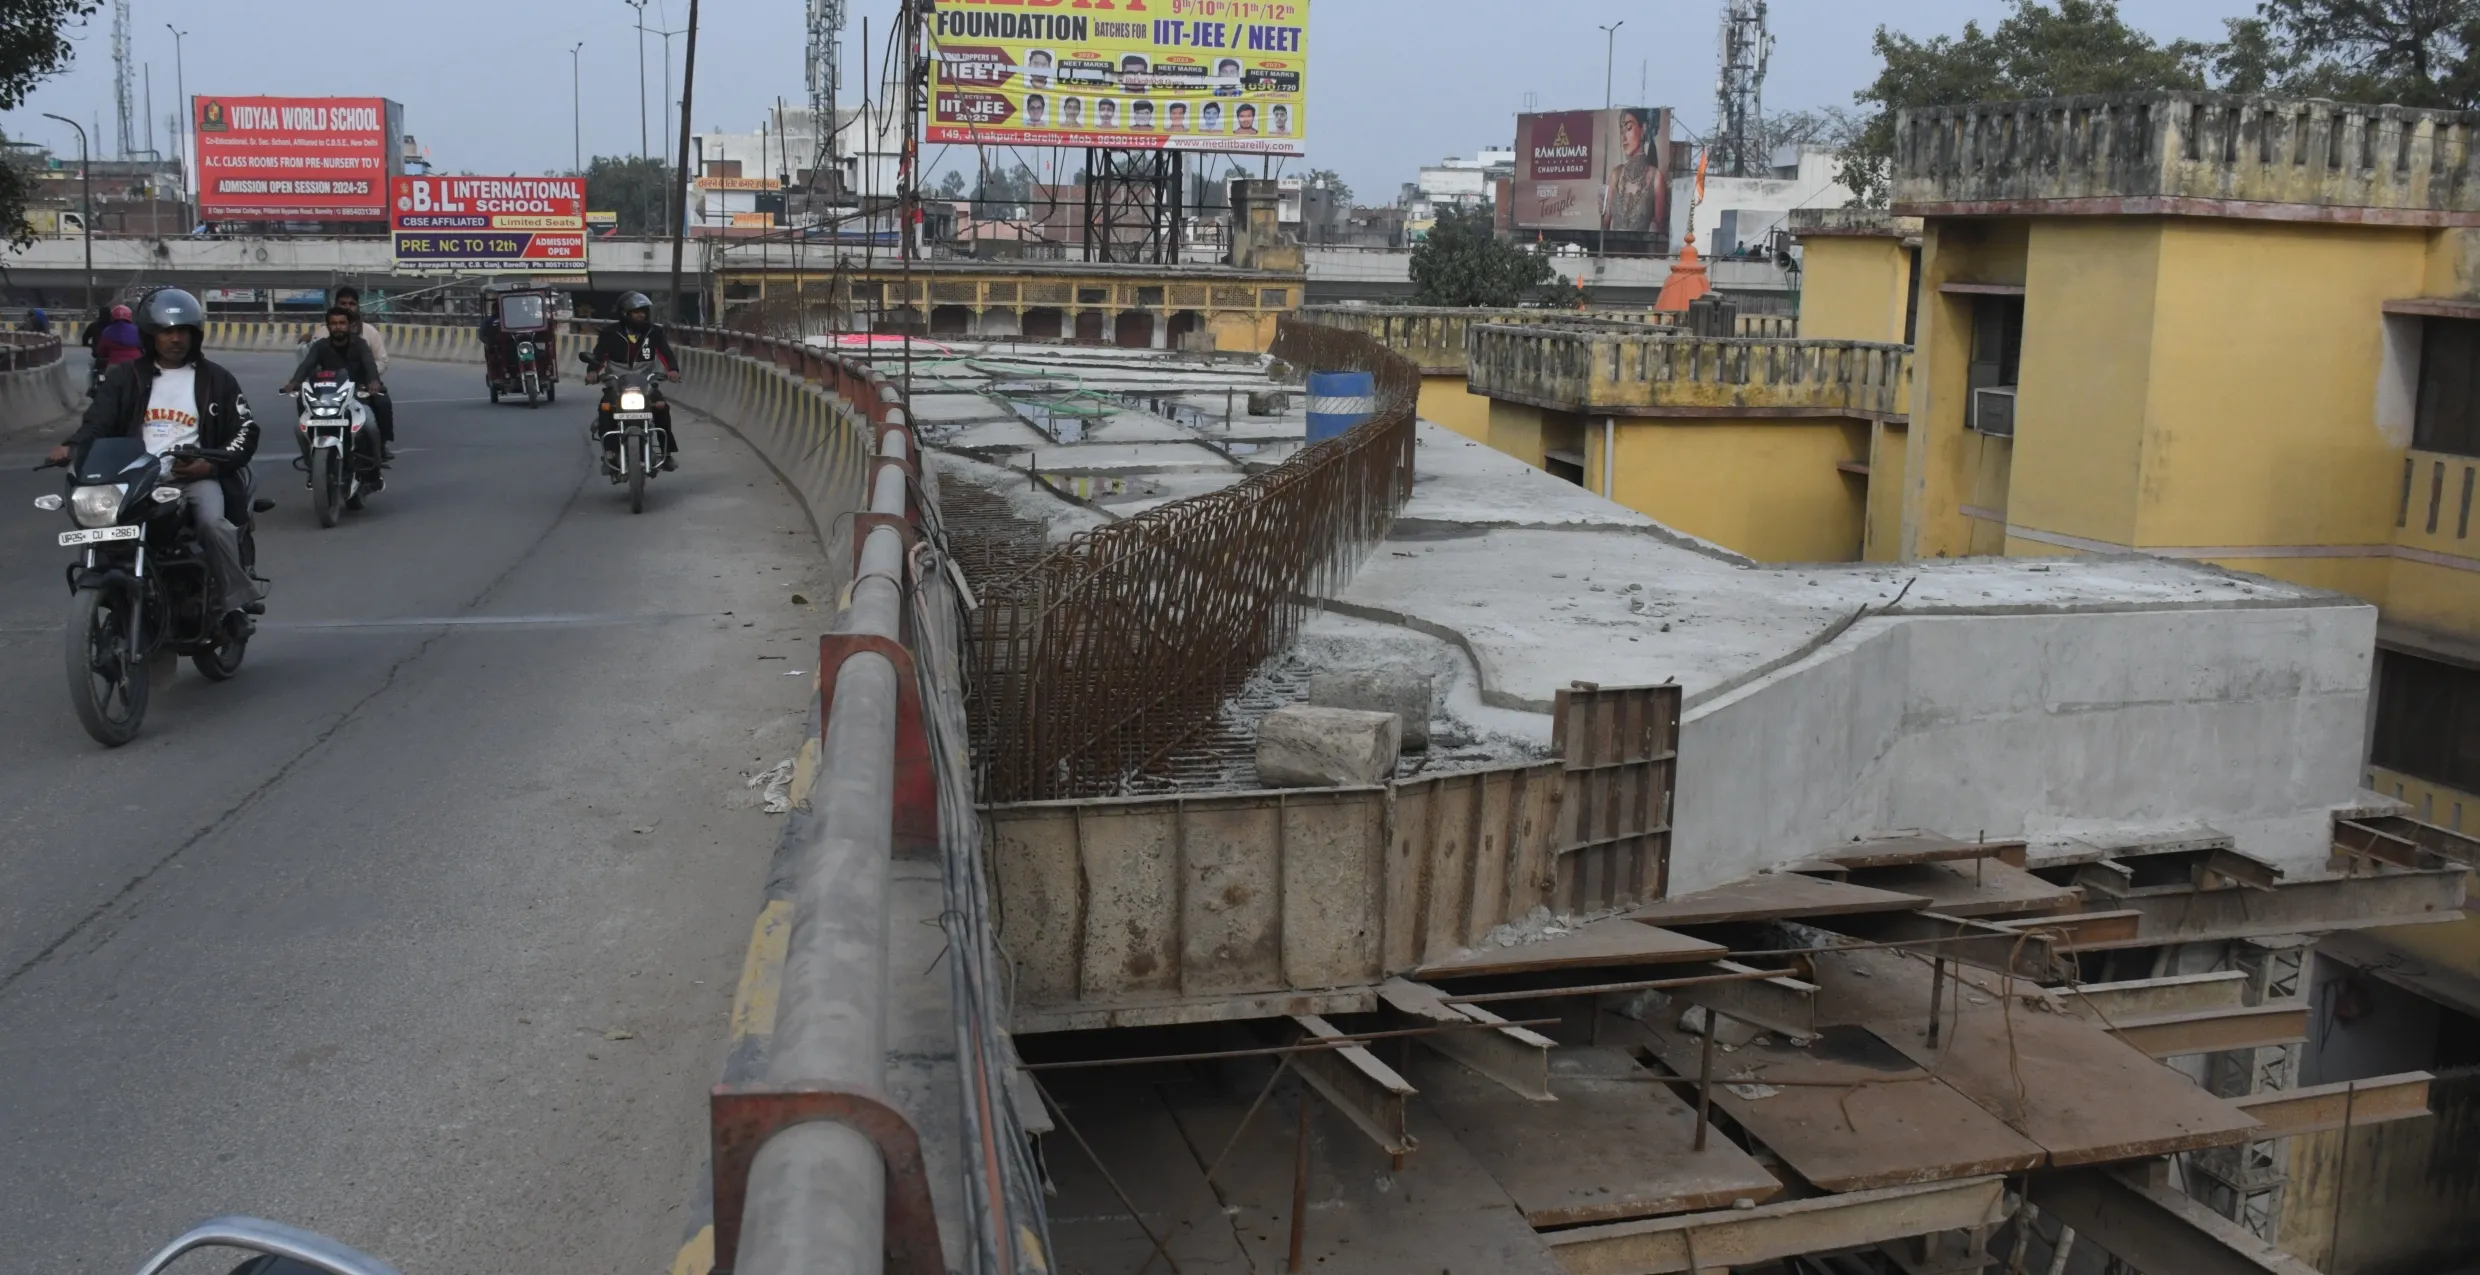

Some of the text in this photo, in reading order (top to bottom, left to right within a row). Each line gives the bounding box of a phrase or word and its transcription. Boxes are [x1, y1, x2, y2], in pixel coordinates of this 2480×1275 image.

[937, 10, 1088, 41] FOUNDATION
[1094, 21, 1130, 38] BATCHES
[1131, 23, 1147, 39] FOR
[1153, 19, 1226, 48] IIT-JEE
[1248, 24, 1302, 52] NEET
[941, 62, 1004, 80] NEET
[940, 99, 1005, 115] IIT-JEE
[231, 106, 380, 131] VIDYAA WORLD SCHOOL
[955, 113, 989, 122] 2023
[941, 129, 962, 140] 149,
[965, 130, 1020, 142] Jnakpuri,
[1023, 132, 1063, 145] Bareilly
[1069, 134, 1094, 144] Mob.
[1535, 145, 1588, 158] RAM KUMAR
[205, 156, 380, 169] A.C. CLASS ROOMS FROM PRE-NURSERY TO V
[1566, 164, 1584, 172] ROAD
[219, 180, 368, 194] ADMISSION OPEN SESSION 2024-25
[412, 180, 581, 212] B.L. INTERNATIONAL
[1538, 187, 1576, 218] Temple
[476, 200, 555, 212] SCHOOL
[403, 216, 576, 226] CBSE AFFILIATED Limited Seats
[400, 239, 518, 252] PRE. NC TO 12th
[536, 238, 582, 246] ADMISSION
[548, 247, 570, 256] OPEN
